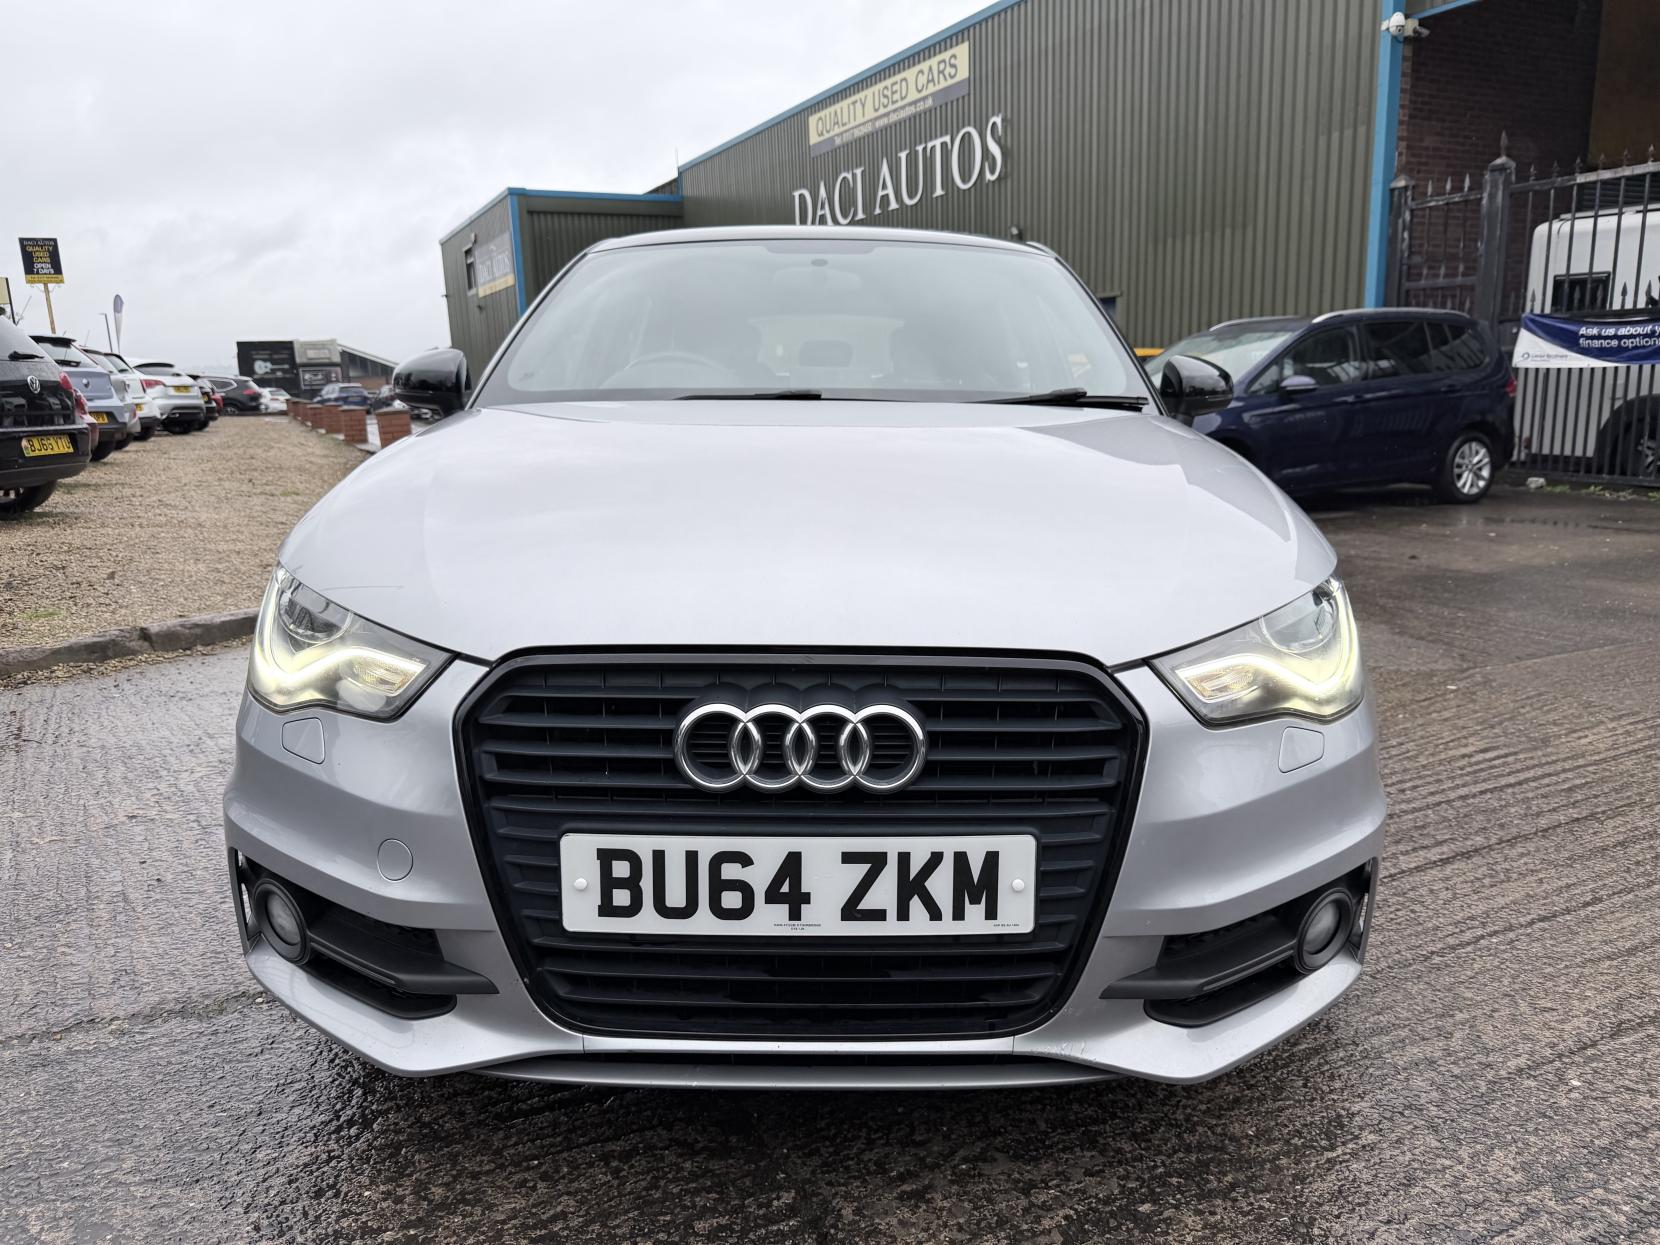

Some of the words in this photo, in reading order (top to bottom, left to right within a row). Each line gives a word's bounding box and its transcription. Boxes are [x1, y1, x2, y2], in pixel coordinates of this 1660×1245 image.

[815, 94, 868, 138] QUALITY
[873, 76, 909, 113] USED
[915, 53, 958, 94] CARS
[793, 167, 866, 226] DACI
[874, 113, 1003, 215] AUTOS
[1579, 326, 1600, 336] Ask
[1601, 327, 1616, 336] us
[1617, 325, 1652, 336] about
[1579, 337, 1619, 348] finance
[28, 438, 54, 452] BJ65
[596, 847, 812, 922] BU64
[840, 850, 1000, 922] ZKM
